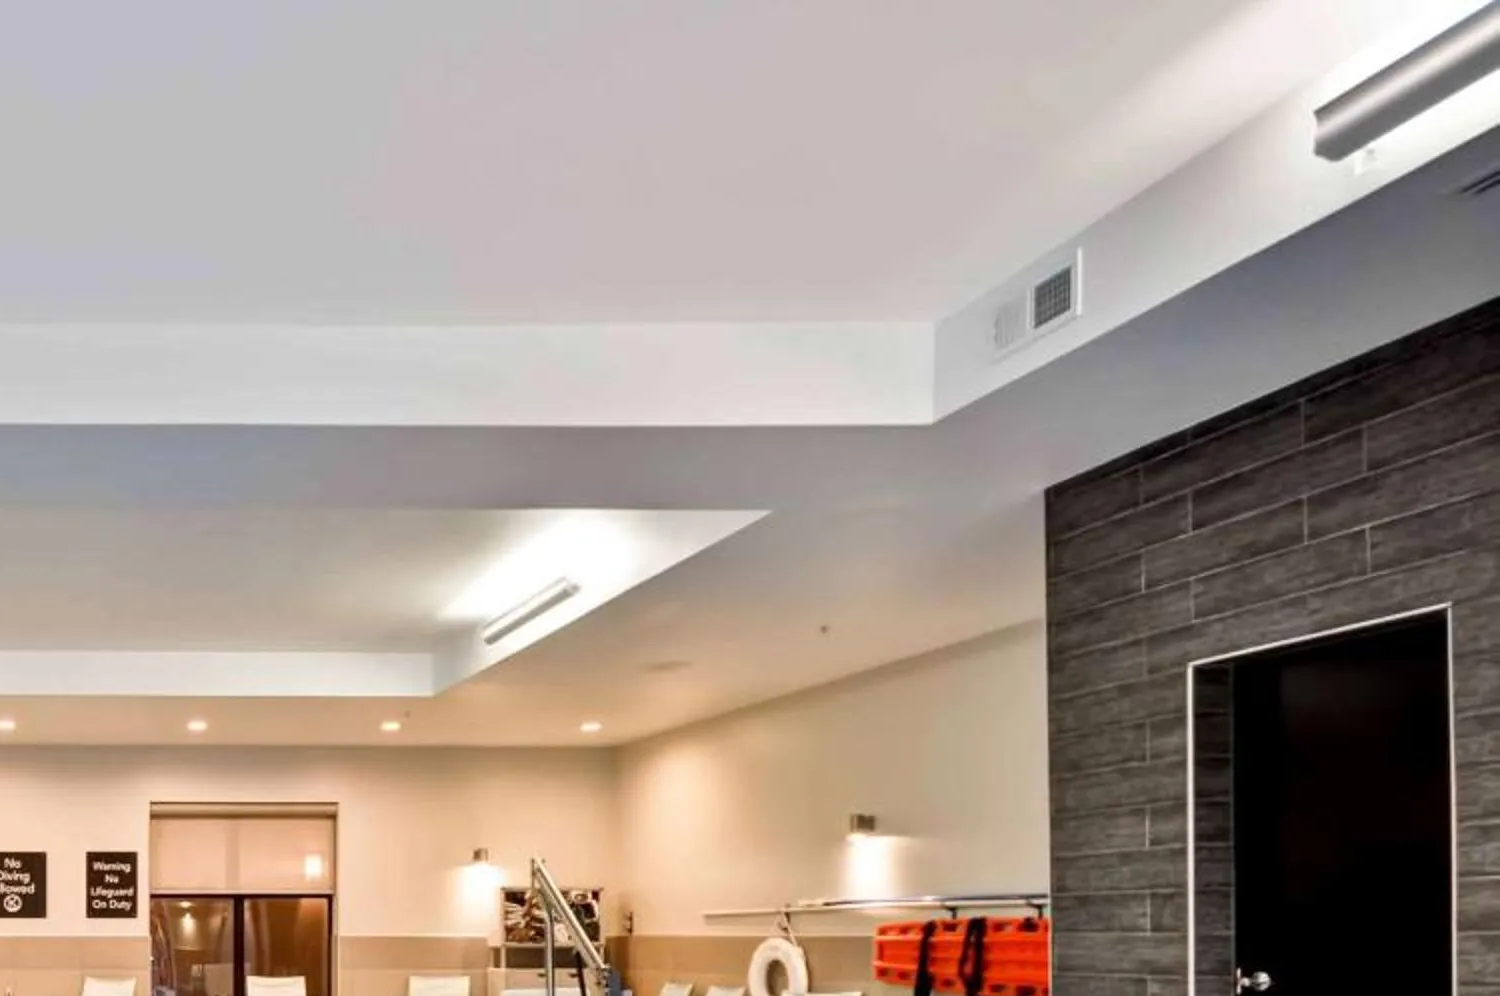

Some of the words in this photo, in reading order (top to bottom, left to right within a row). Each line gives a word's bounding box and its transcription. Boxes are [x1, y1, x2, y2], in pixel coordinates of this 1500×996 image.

[3, 857, 22, 869] No
[92, 861, 131, 873] Warning
[105, 874, 119, 883] No
[90, 886, 134, 898] Lifeguard
[91, 899, 107, 909] On
[109, 899, 132, 911] Duty
